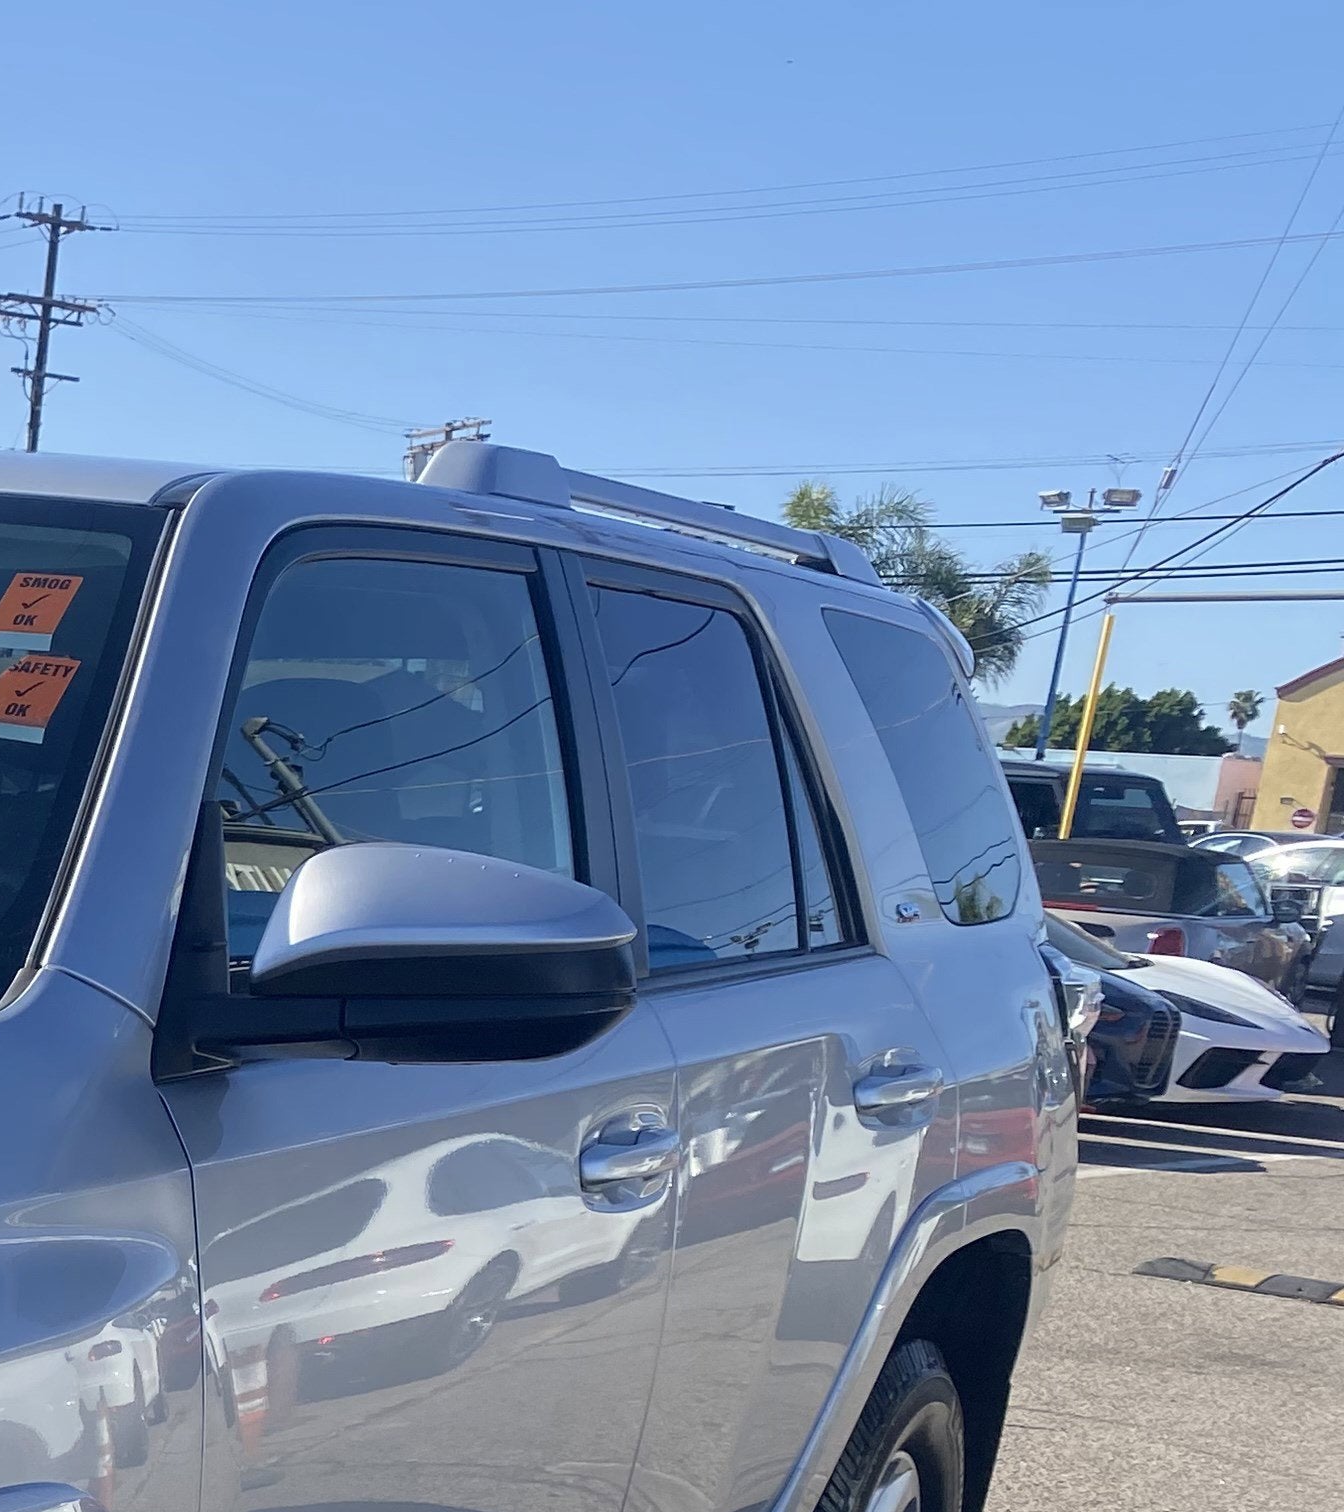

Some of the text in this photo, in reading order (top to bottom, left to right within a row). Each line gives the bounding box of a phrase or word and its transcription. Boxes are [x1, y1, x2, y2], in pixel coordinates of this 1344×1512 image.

[20, 577, 72, 590] SMOG
[13, 614, 38, 626] OK
[9, 660, 74, 678] SAFETY
[5, 702, 31, 717] OK
